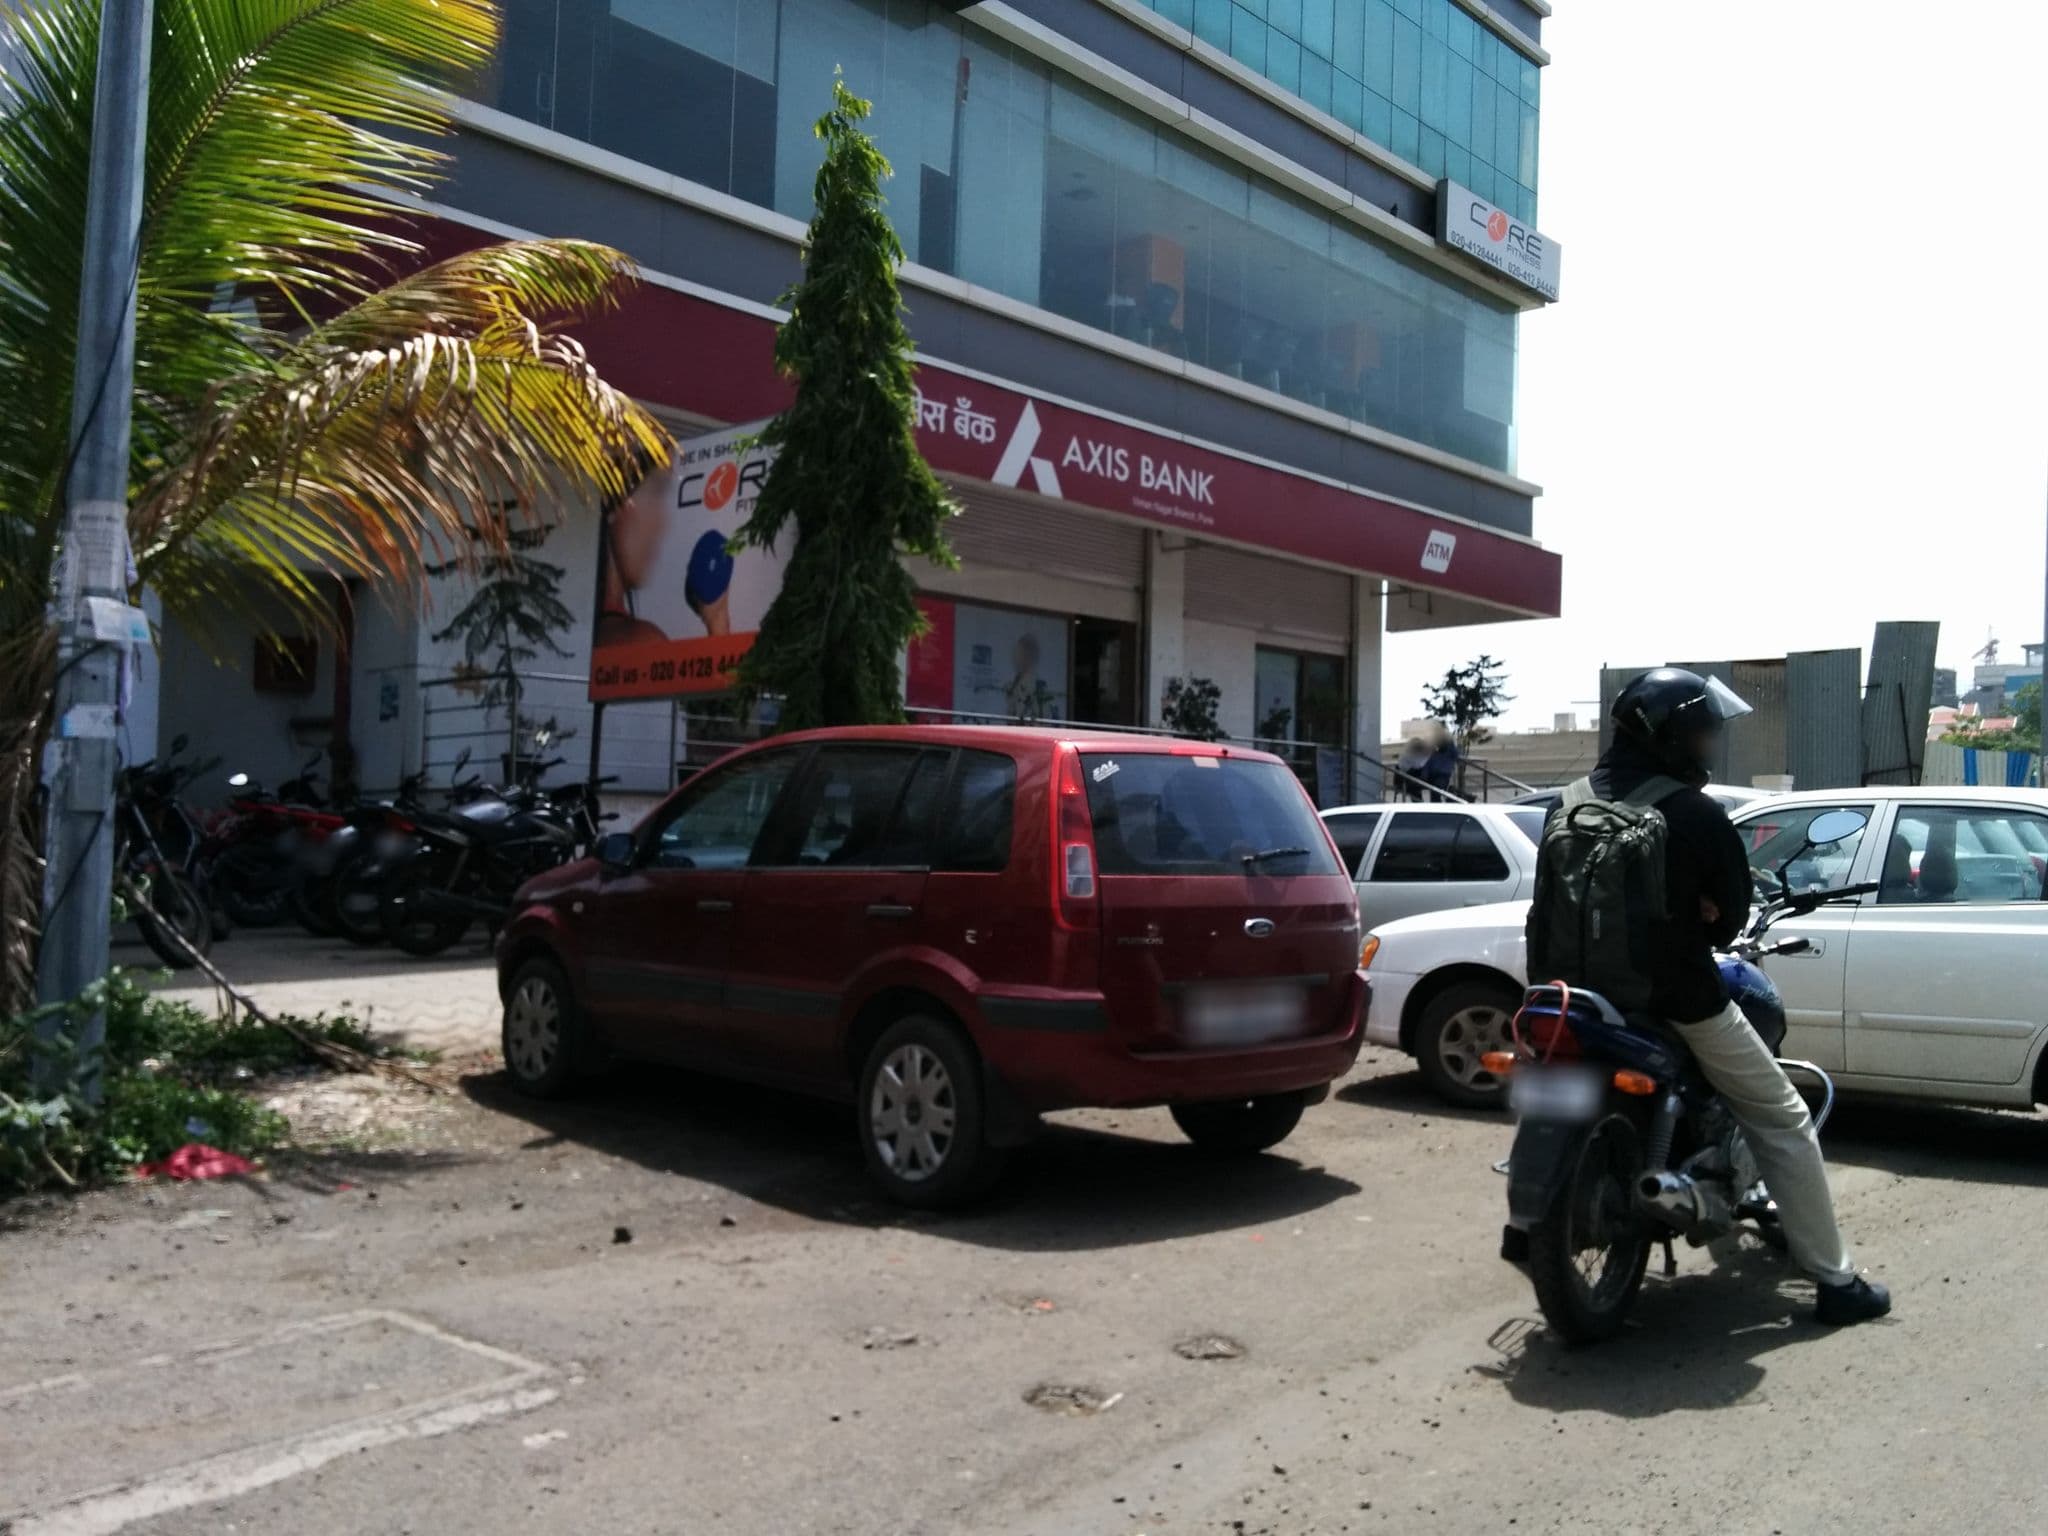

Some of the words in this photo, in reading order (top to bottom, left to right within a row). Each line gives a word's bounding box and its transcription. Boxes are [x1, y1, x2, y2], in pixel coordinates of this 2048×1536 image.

[1507, 243, 1541, 269] FITNESS
[698, 447, 711, 461] IN
[677, 459, 772, 511] COR
[1062, 436, 1130, 483] AXIS
[1140, 454, 1215, 506] BANK
[1426, 542, 1450, 561] ATM
[595, 665, 619, 686] Call
[623, 668, 639, 683] us
[651, 660, 675, 682] 020
[679, 656, 713, 678] 4128
